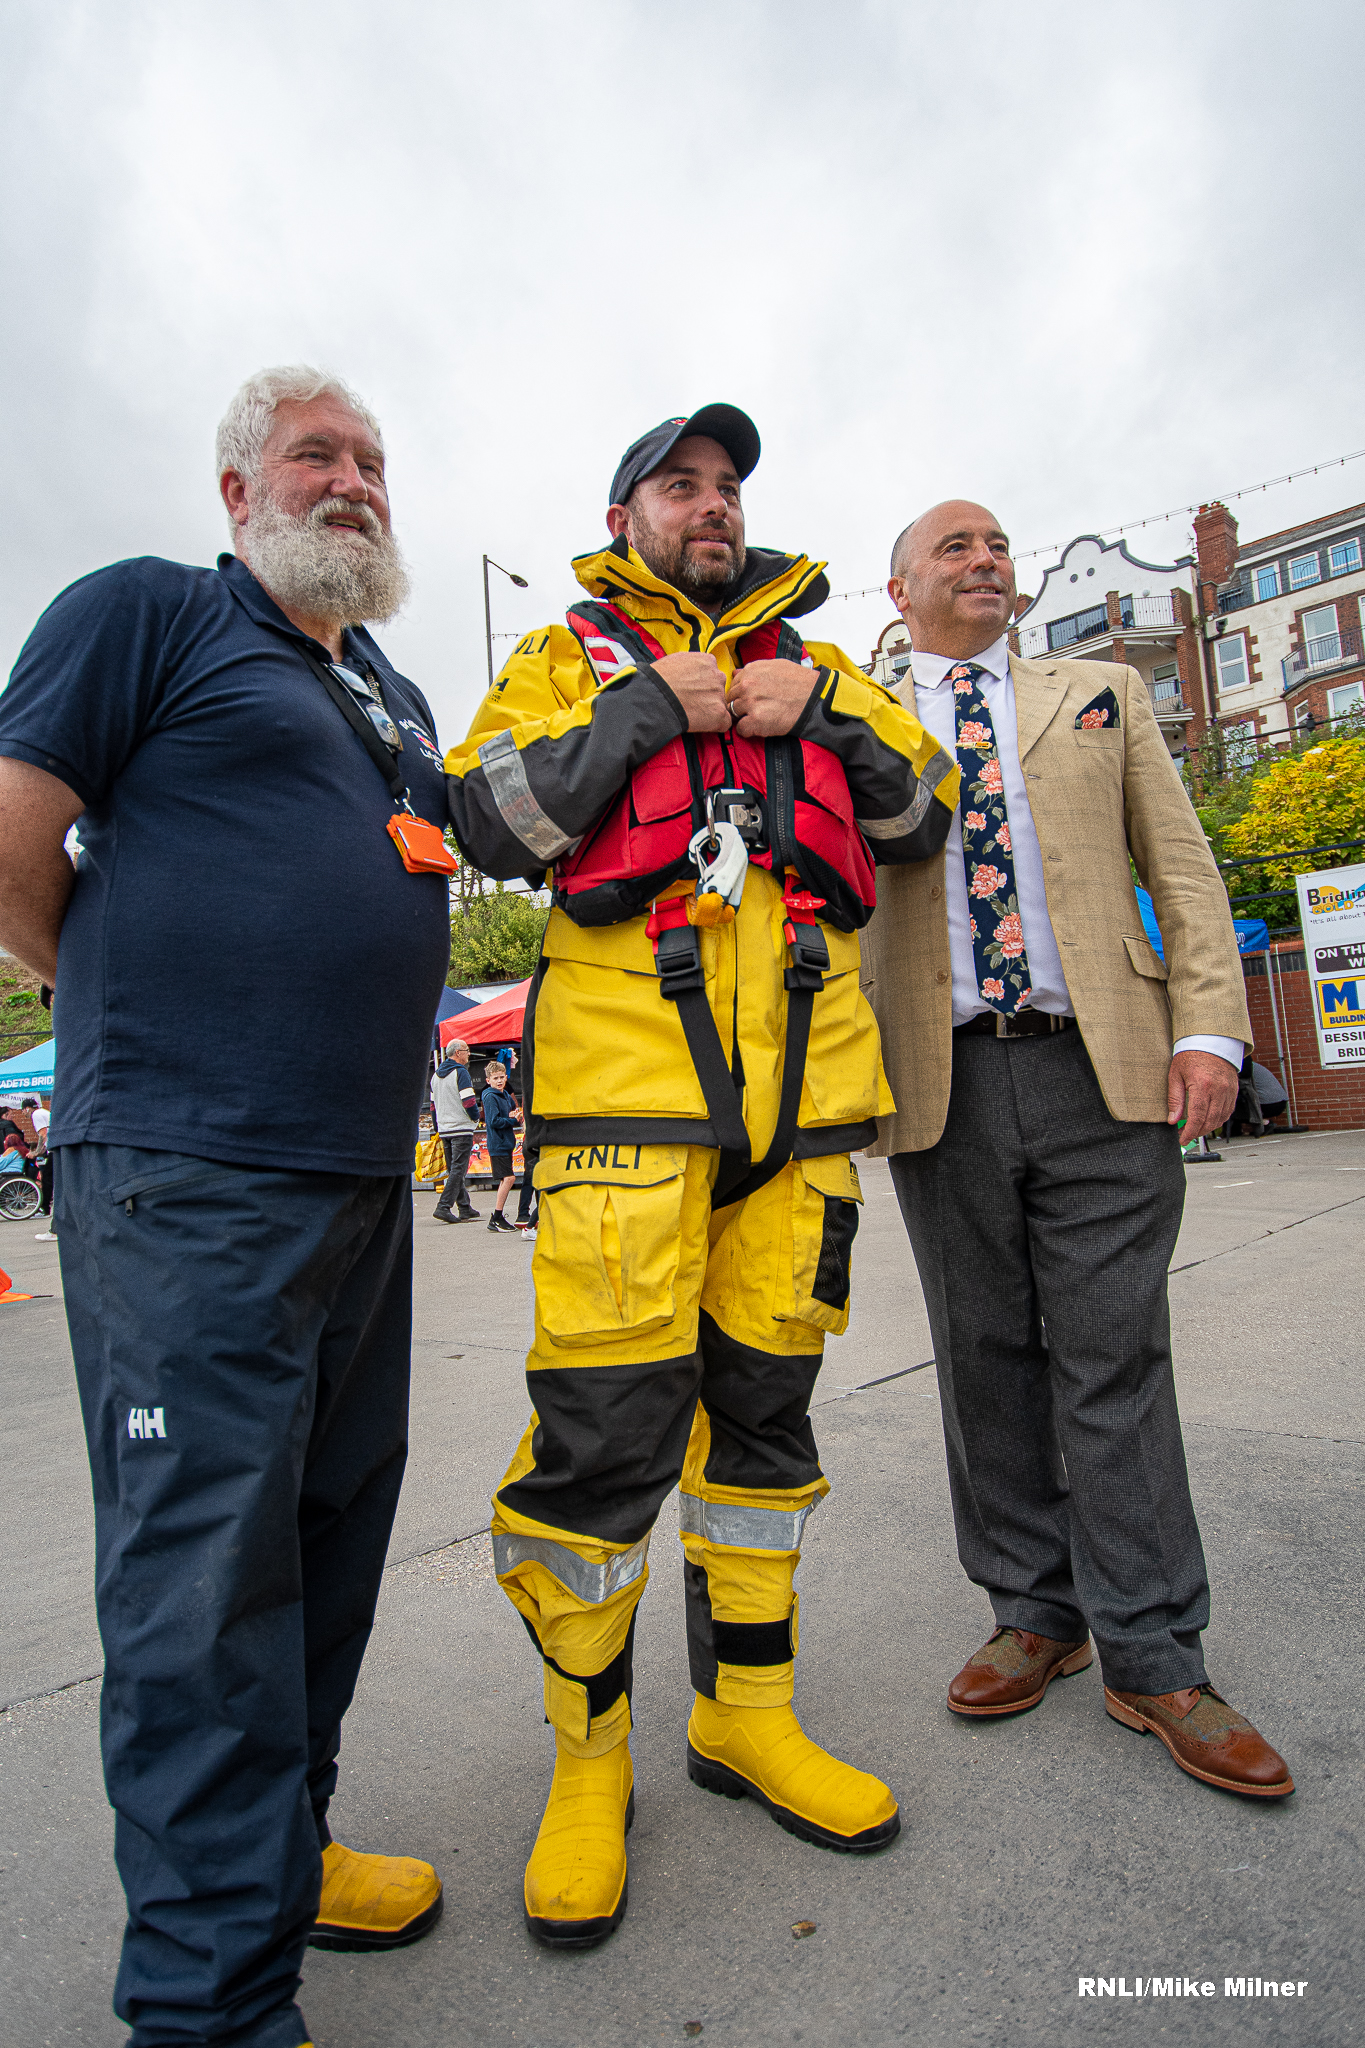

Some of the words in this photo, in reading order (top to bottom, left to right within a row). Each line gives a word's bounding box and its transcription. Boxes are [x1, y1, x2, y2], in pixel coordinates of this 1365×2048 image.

[1312, 900, 1354, 915] GOLD
[1315, 947, 1338, 960] ON
[1325, 1031, 1365, 1043] BESSI
[0, 1077, 30, 1089] ADETS
[565, 1145, 641, 1171] RNLI
[128, 1407, 167, 1439] HH
